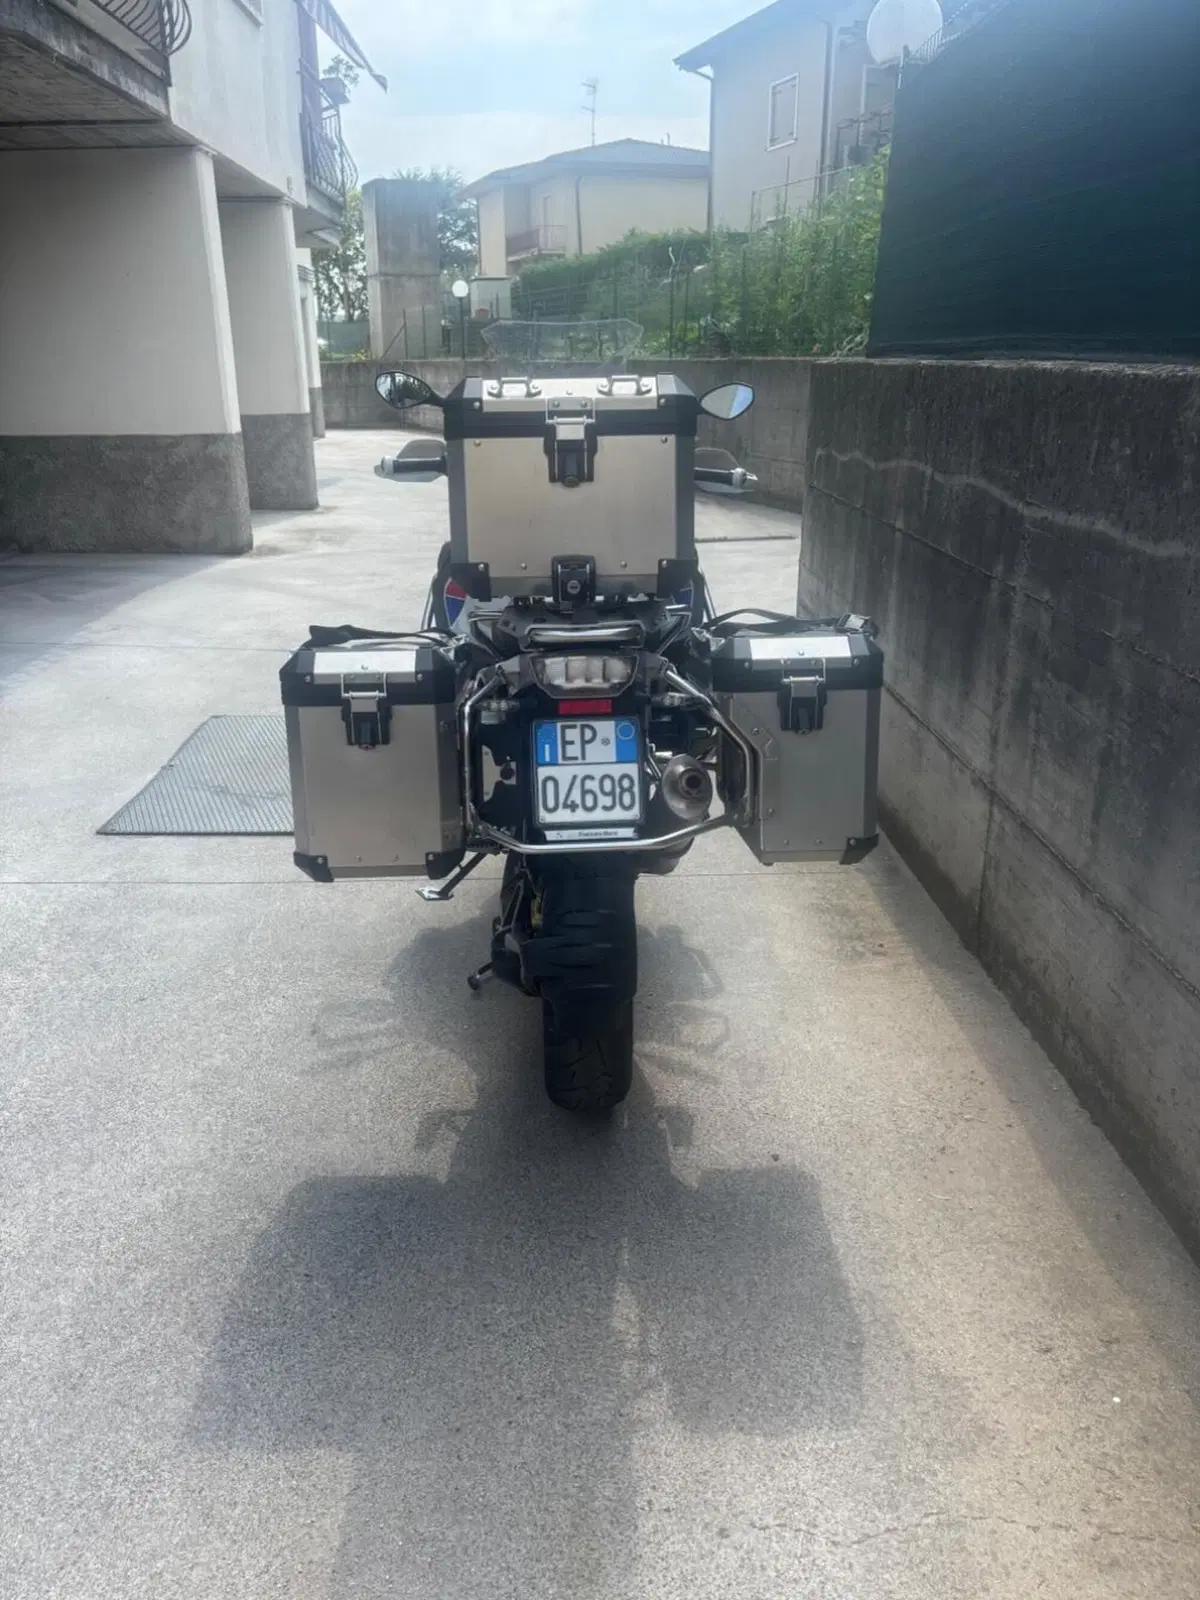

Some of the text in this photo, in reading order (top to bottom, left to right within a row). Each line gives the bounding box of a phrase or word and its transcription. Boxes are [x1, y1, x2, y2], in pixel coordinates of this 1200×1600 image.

[544, 744, 550, 762] I
[560, 723, 597, 761] EP
[541, 773, 636, 814] 04698
